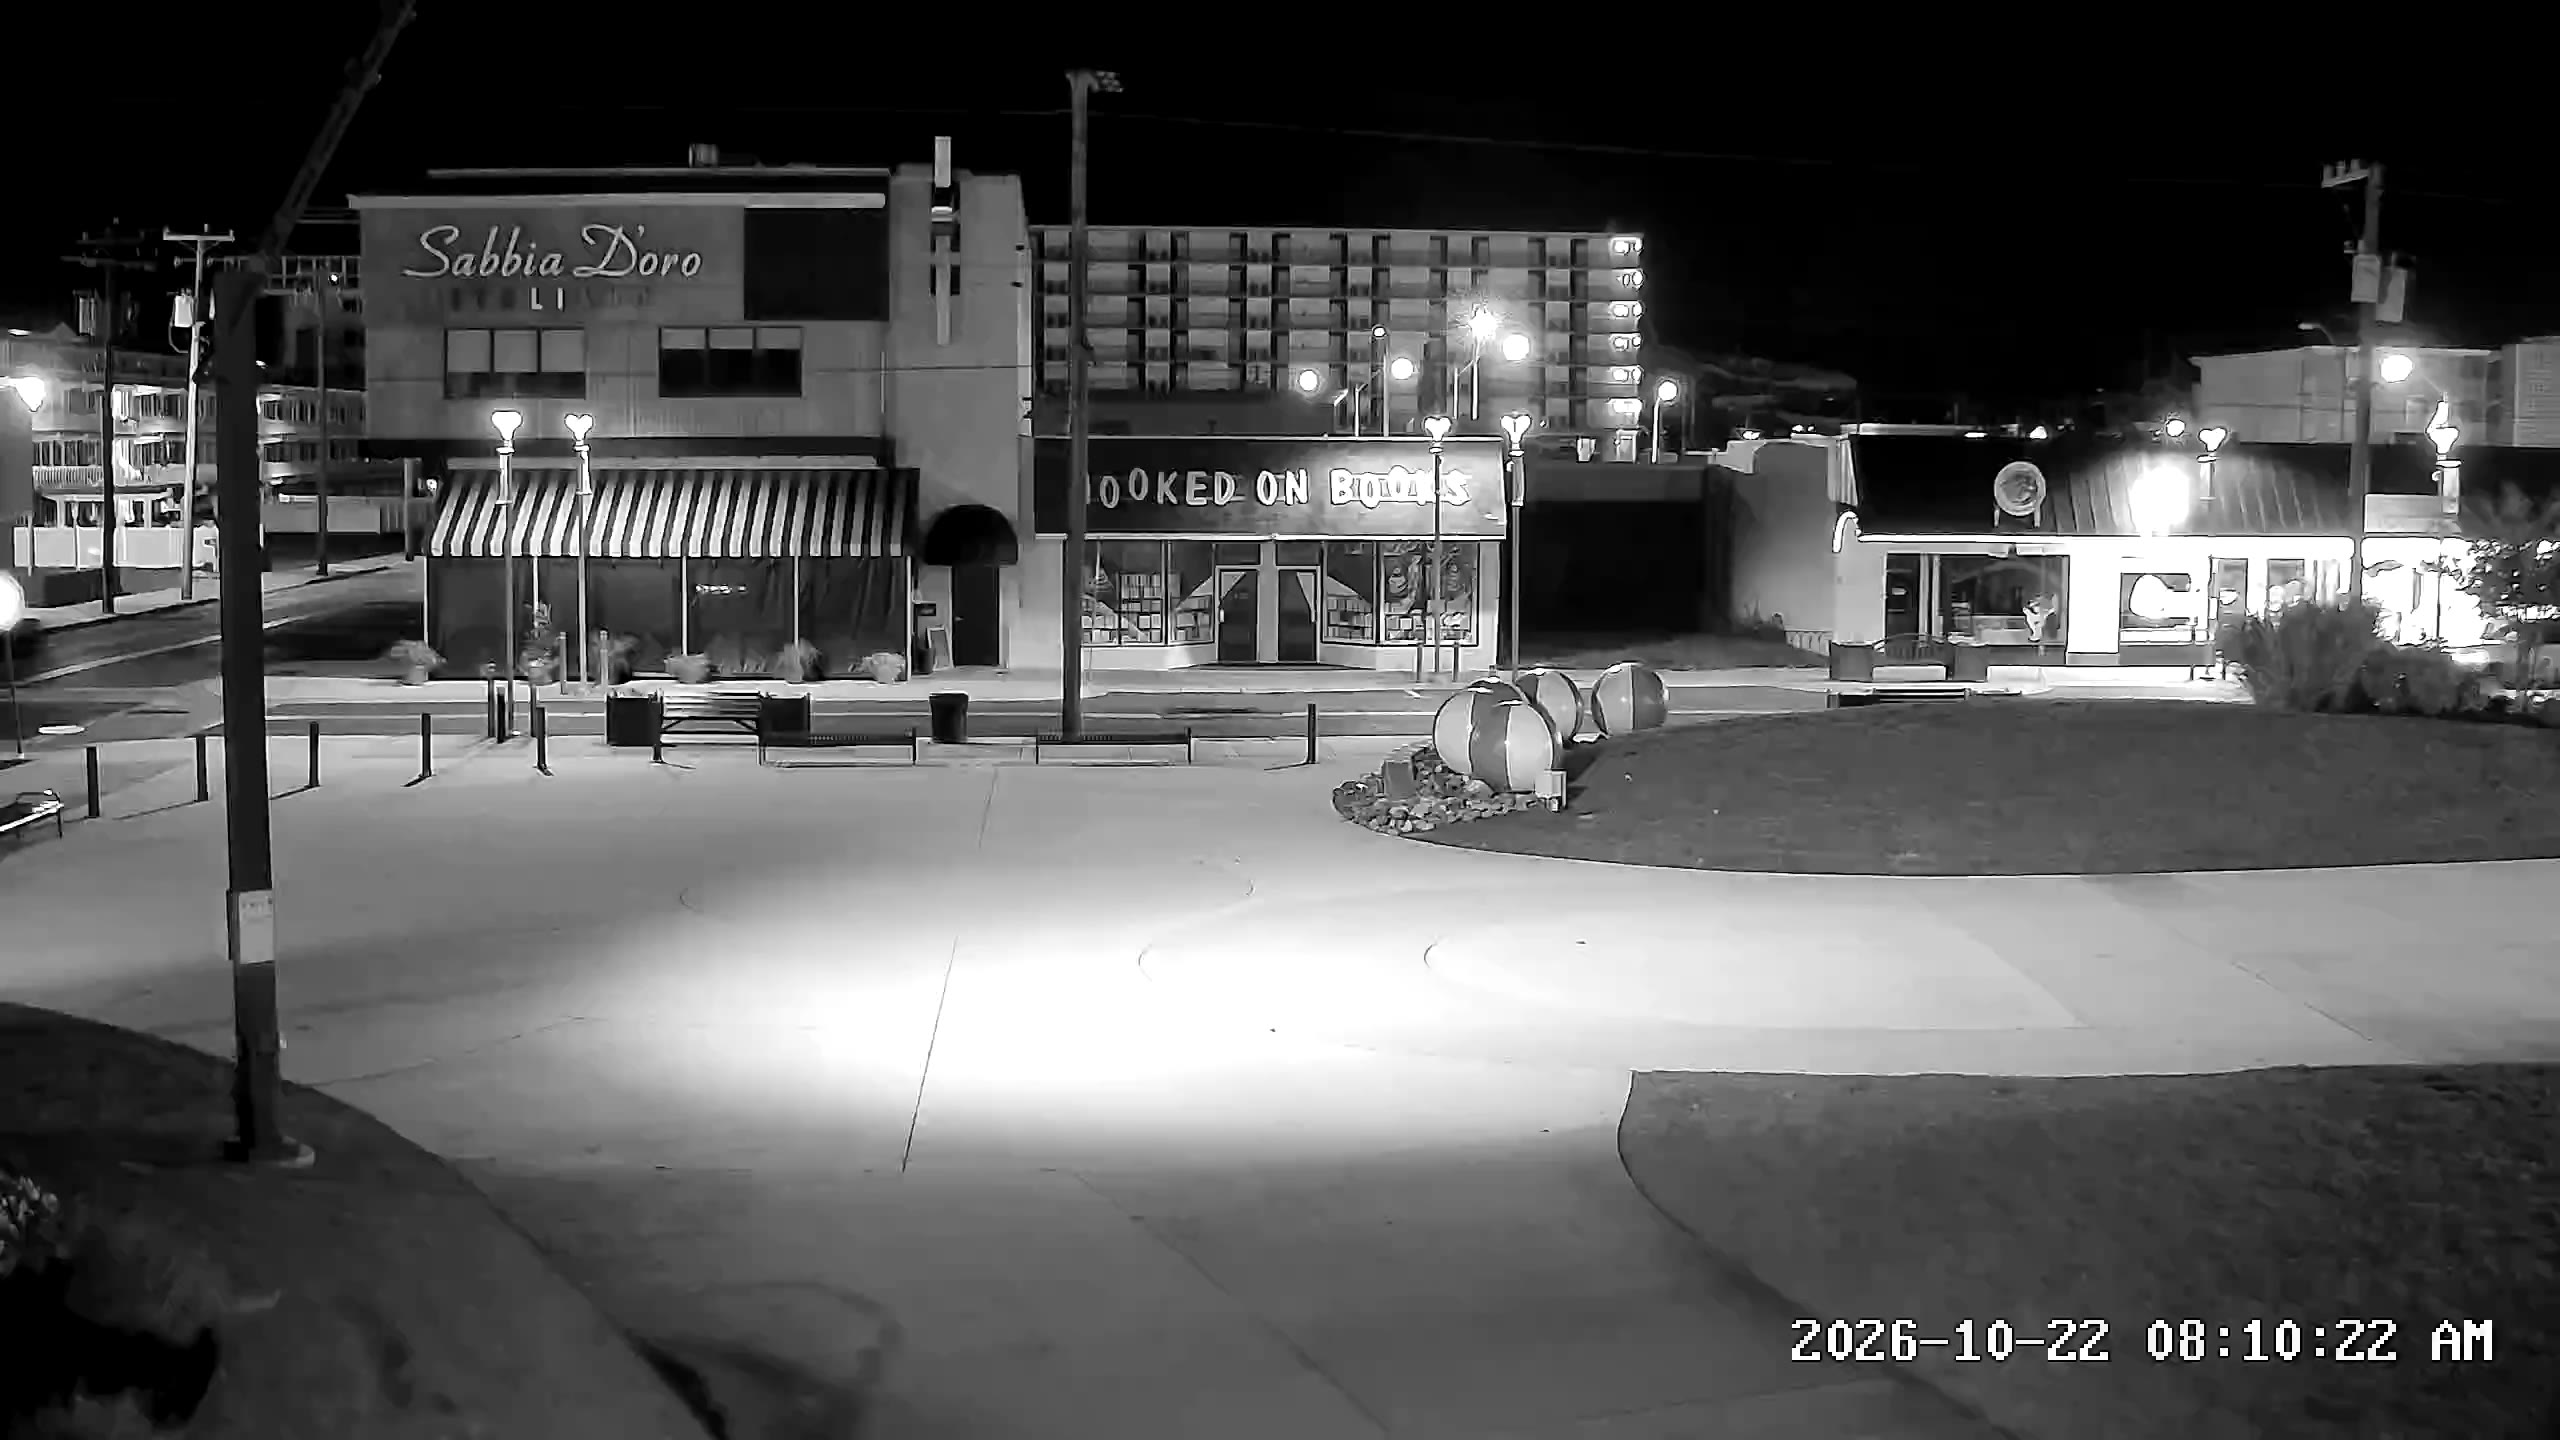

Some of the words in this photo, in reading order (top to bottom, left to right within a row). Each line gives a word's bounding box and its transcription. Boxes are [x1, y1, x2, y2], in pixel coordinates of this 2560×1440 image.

[402, 224, 565, 278] Sabbia
[572, 223, 702, 278] D'oro
[1086, 467, 1236, 509] OOKED
[1256, 469, 1309, 506] ON
